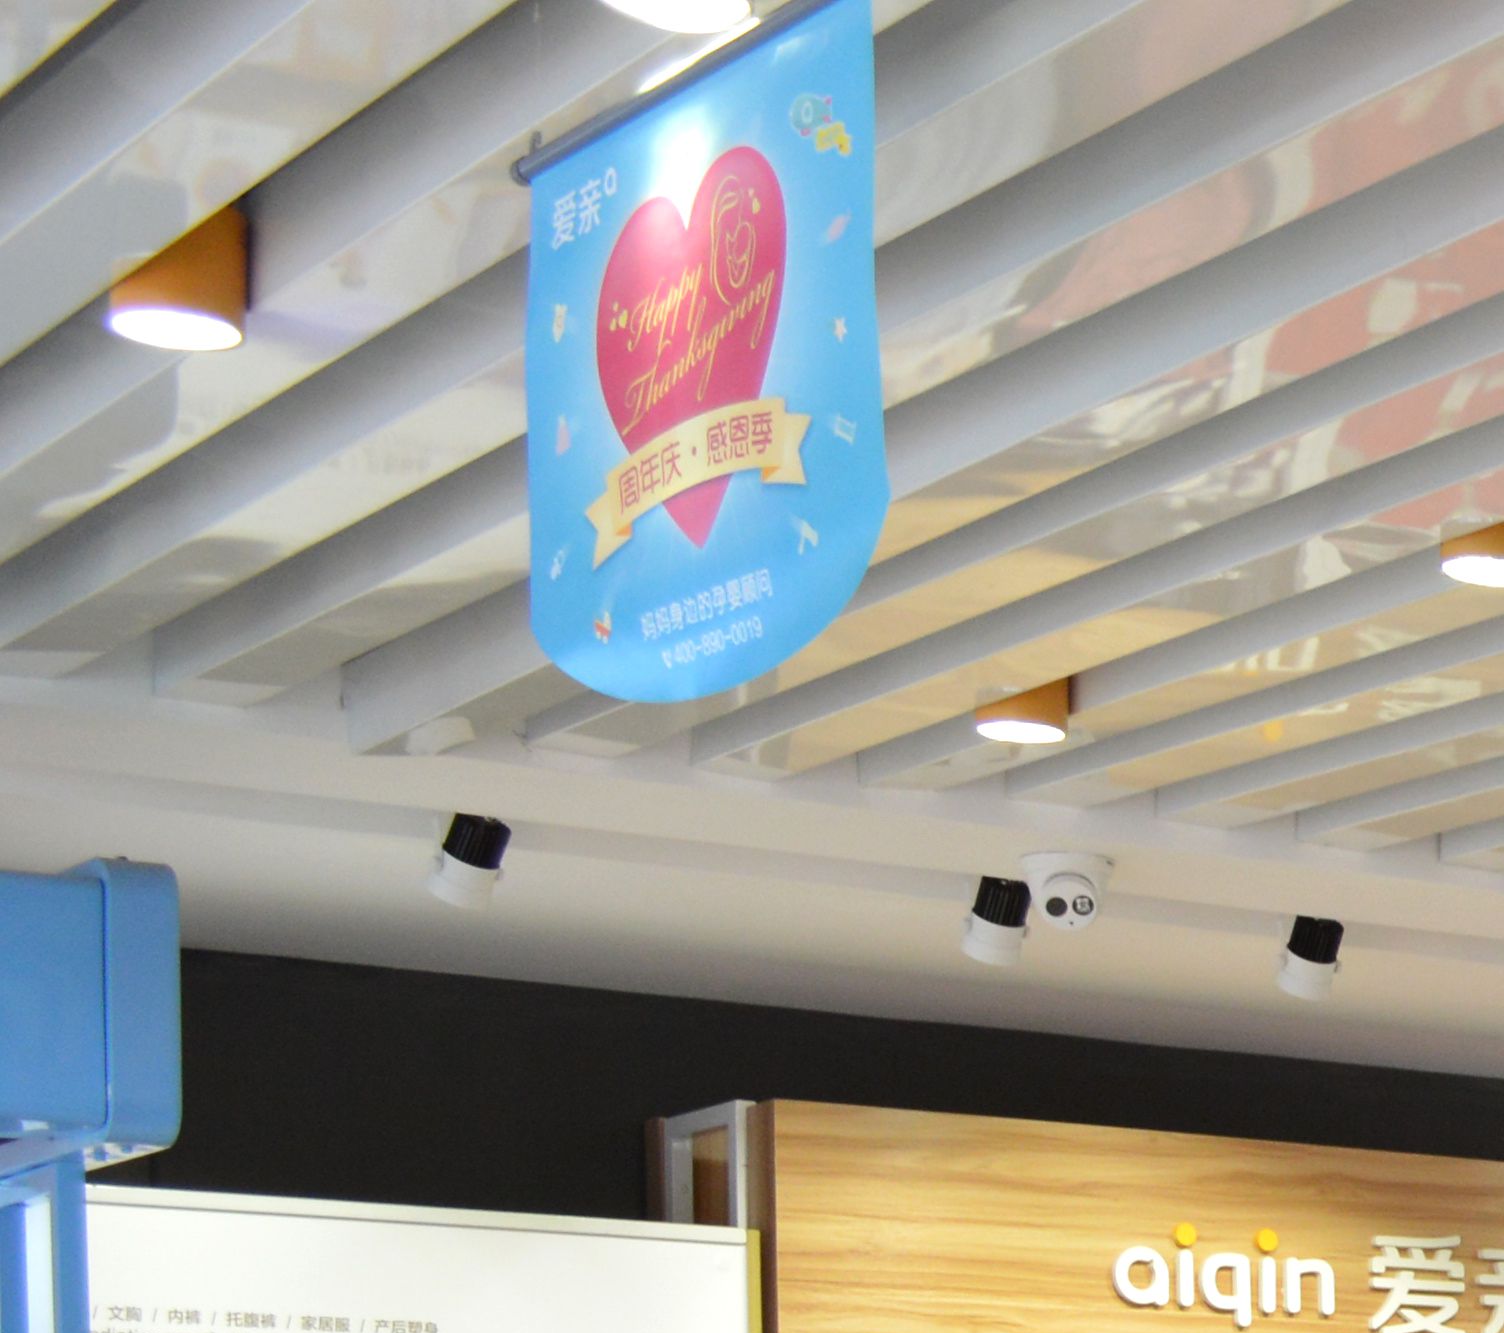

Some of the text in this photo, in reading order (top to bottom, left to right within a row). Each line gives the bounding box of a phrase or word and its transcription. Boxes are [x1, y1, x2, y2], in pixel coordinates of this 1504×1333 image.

[550, 178, 603, 250] 爱亲
[627, 262, 706, 354] Happy
[620, 268, 775, 438] Thanksgiving
[641, 568, 773, 642] 妈妈身边的孕婴顾问
[1112, 1221, 1335, 1328] aiqin
[167, 1308, 200, 1325] 内裤
[300, 1314, 350, 1333] 家居服
